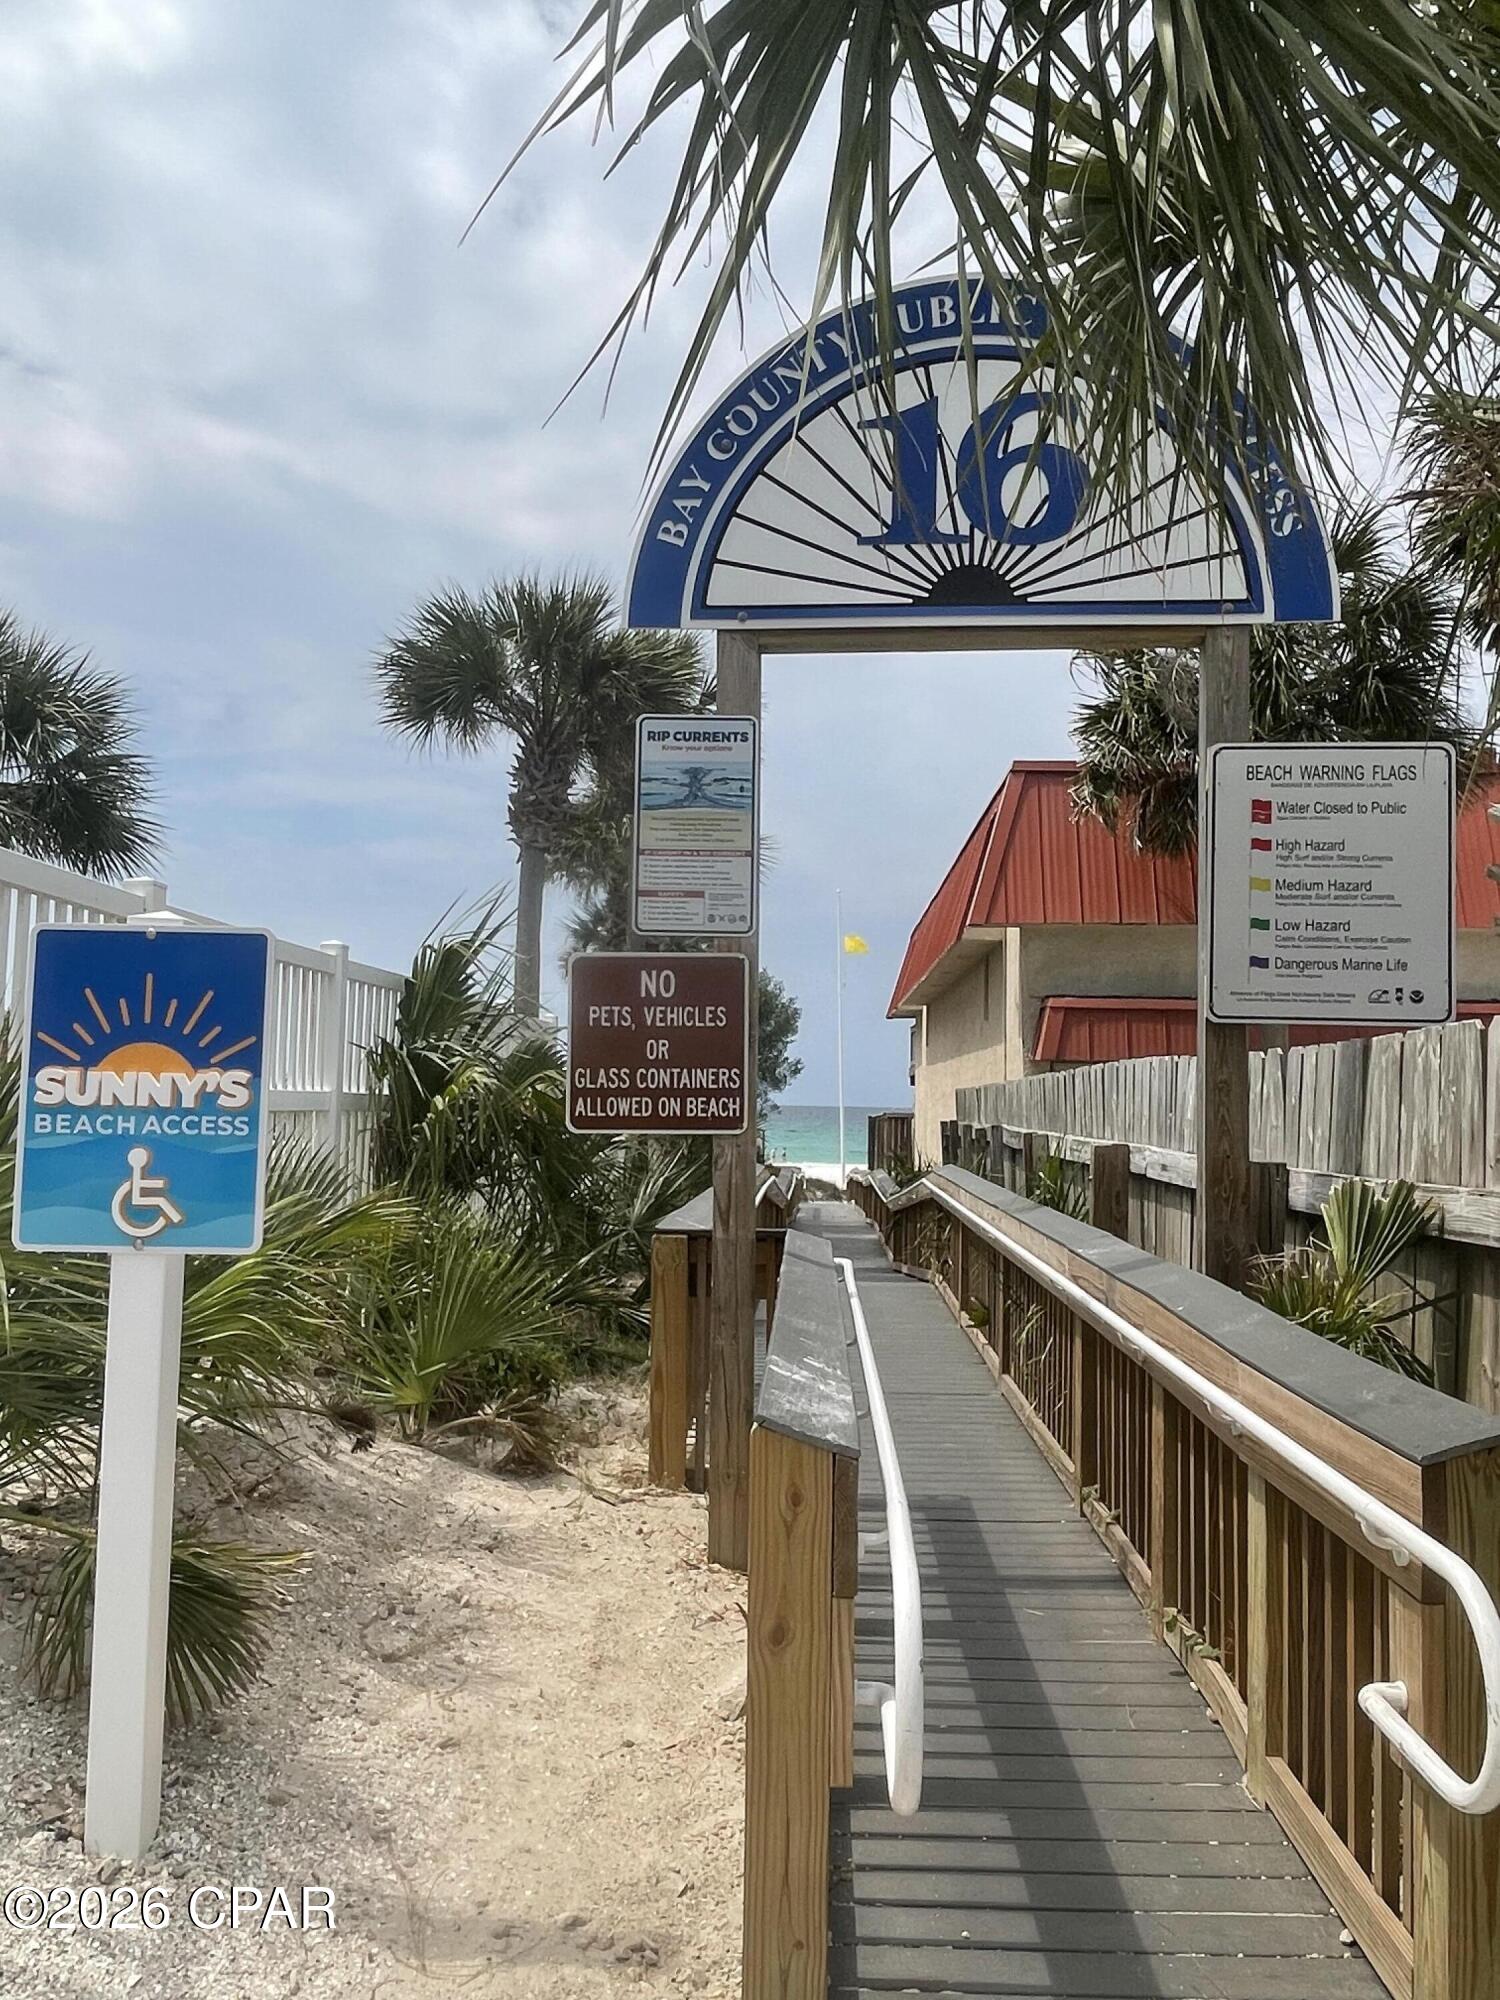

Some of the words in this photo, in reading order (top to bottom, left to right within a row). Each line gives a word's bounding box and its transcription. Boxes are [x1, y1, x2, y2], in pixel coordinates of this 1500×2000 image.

[656, 464, 712, 548] BAY
[706, 330, 855, 461] COUNTY
[857, 391, 1091, 546] 16
[647, 731, 671, 742] RIP
[673, 731, 749, 743] CURRENTS
[1246, 764, 1292, 781] BEACH
[1300, 764, 1365, 781] WARNING
[1373, 764, 1417, 781] FLAGS
[1276, 801, 1310, 815] Water
[1314, 801, 1353, 815] Closed
[1357, 802, 1368, 815] to
[1371, 801, 1407, 815] Public
[1275, 839, 1301, 854] High
[1305, 839, 1345, 851] Hazard
[1275, 879, 1324, 892] Medium
[1328, 879, 1372, 892] Hazard
[1274, 918, 1301, 931] Low
[1305, 919, 1351, 932] Hazard
[1274, 957, 1338, 973] Dangerous
[1342, 958, 1383, 971] Marine
[1386, 958, 1409, 972] Life
[640, 969, 676, 998] NO
[589, 1005, 636, 1031] PETS,
[643, 1006, 727, 1027] VEHICLES
[646, 1039, 669, 1060] OR
[33, 1066, 253, 1109] SUNNY'S
[575, 1067, 630, 1089] GLASS
[636, 1068, 741, 1089] CONTAINERS
[575, 1097, 652, 1117] ALLOWED
[658, 1097, 680, 1117] ON
[686, 1097, 740, 1117] BEACH
[33, 1113, 135, 1136] BEACH
[141, 1114, 250, 1136] ACCESS
